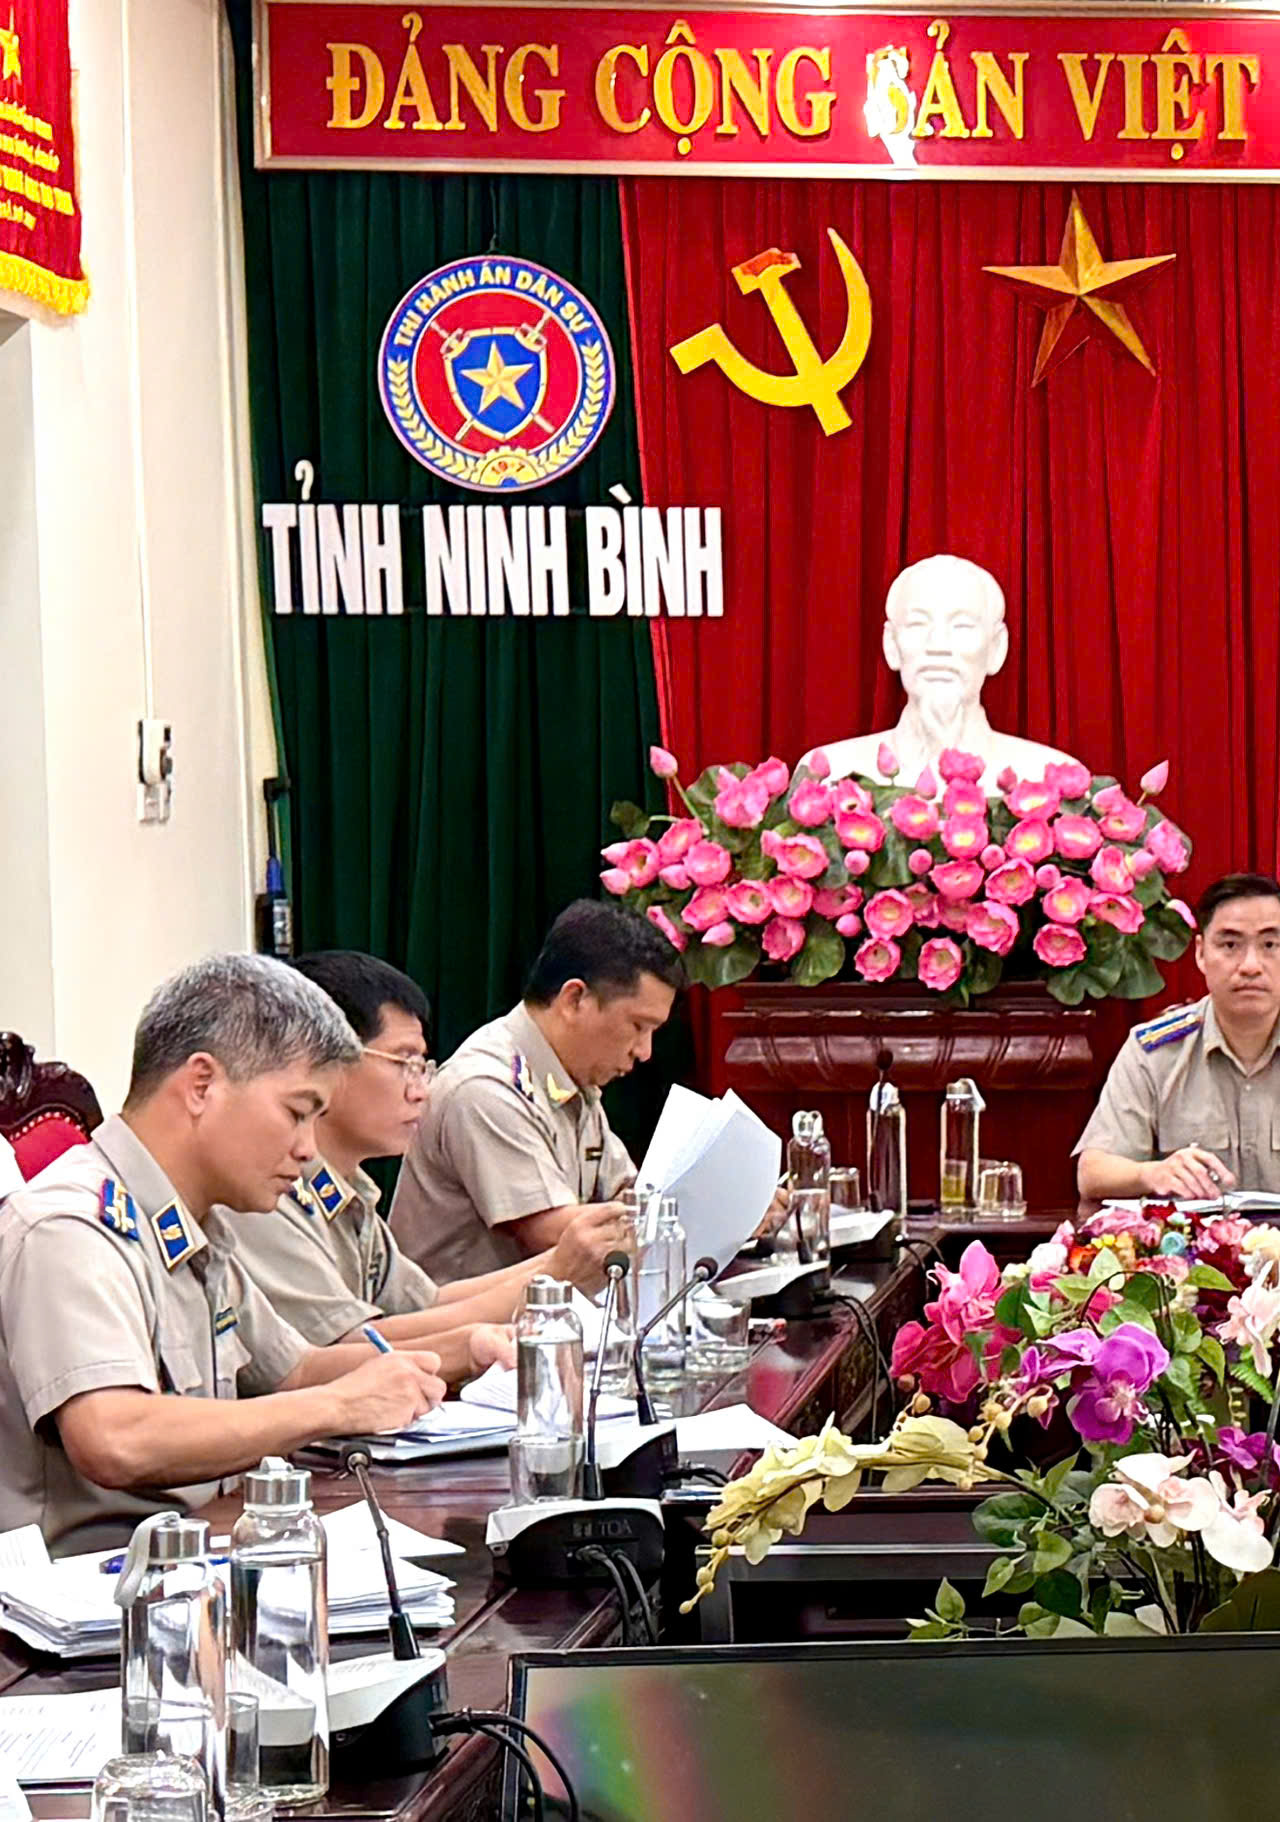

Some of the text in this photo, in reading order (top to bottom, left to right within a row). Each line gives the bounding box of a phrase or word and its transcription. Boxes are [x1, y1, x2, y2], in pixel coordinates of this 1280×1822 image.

[326, 12, 565, 132] ĐẢNG
[595, 19, 834, 155] CỘNG
[1057, 27, 1258, 160] VIỆT
[393, 309, 423, 346] THI
[480, 261, 511, 286] ÁN
[262, 459, 724, 617] TỈNH NINH BÌNH
[599, 1519, 633, 1537] TOA
